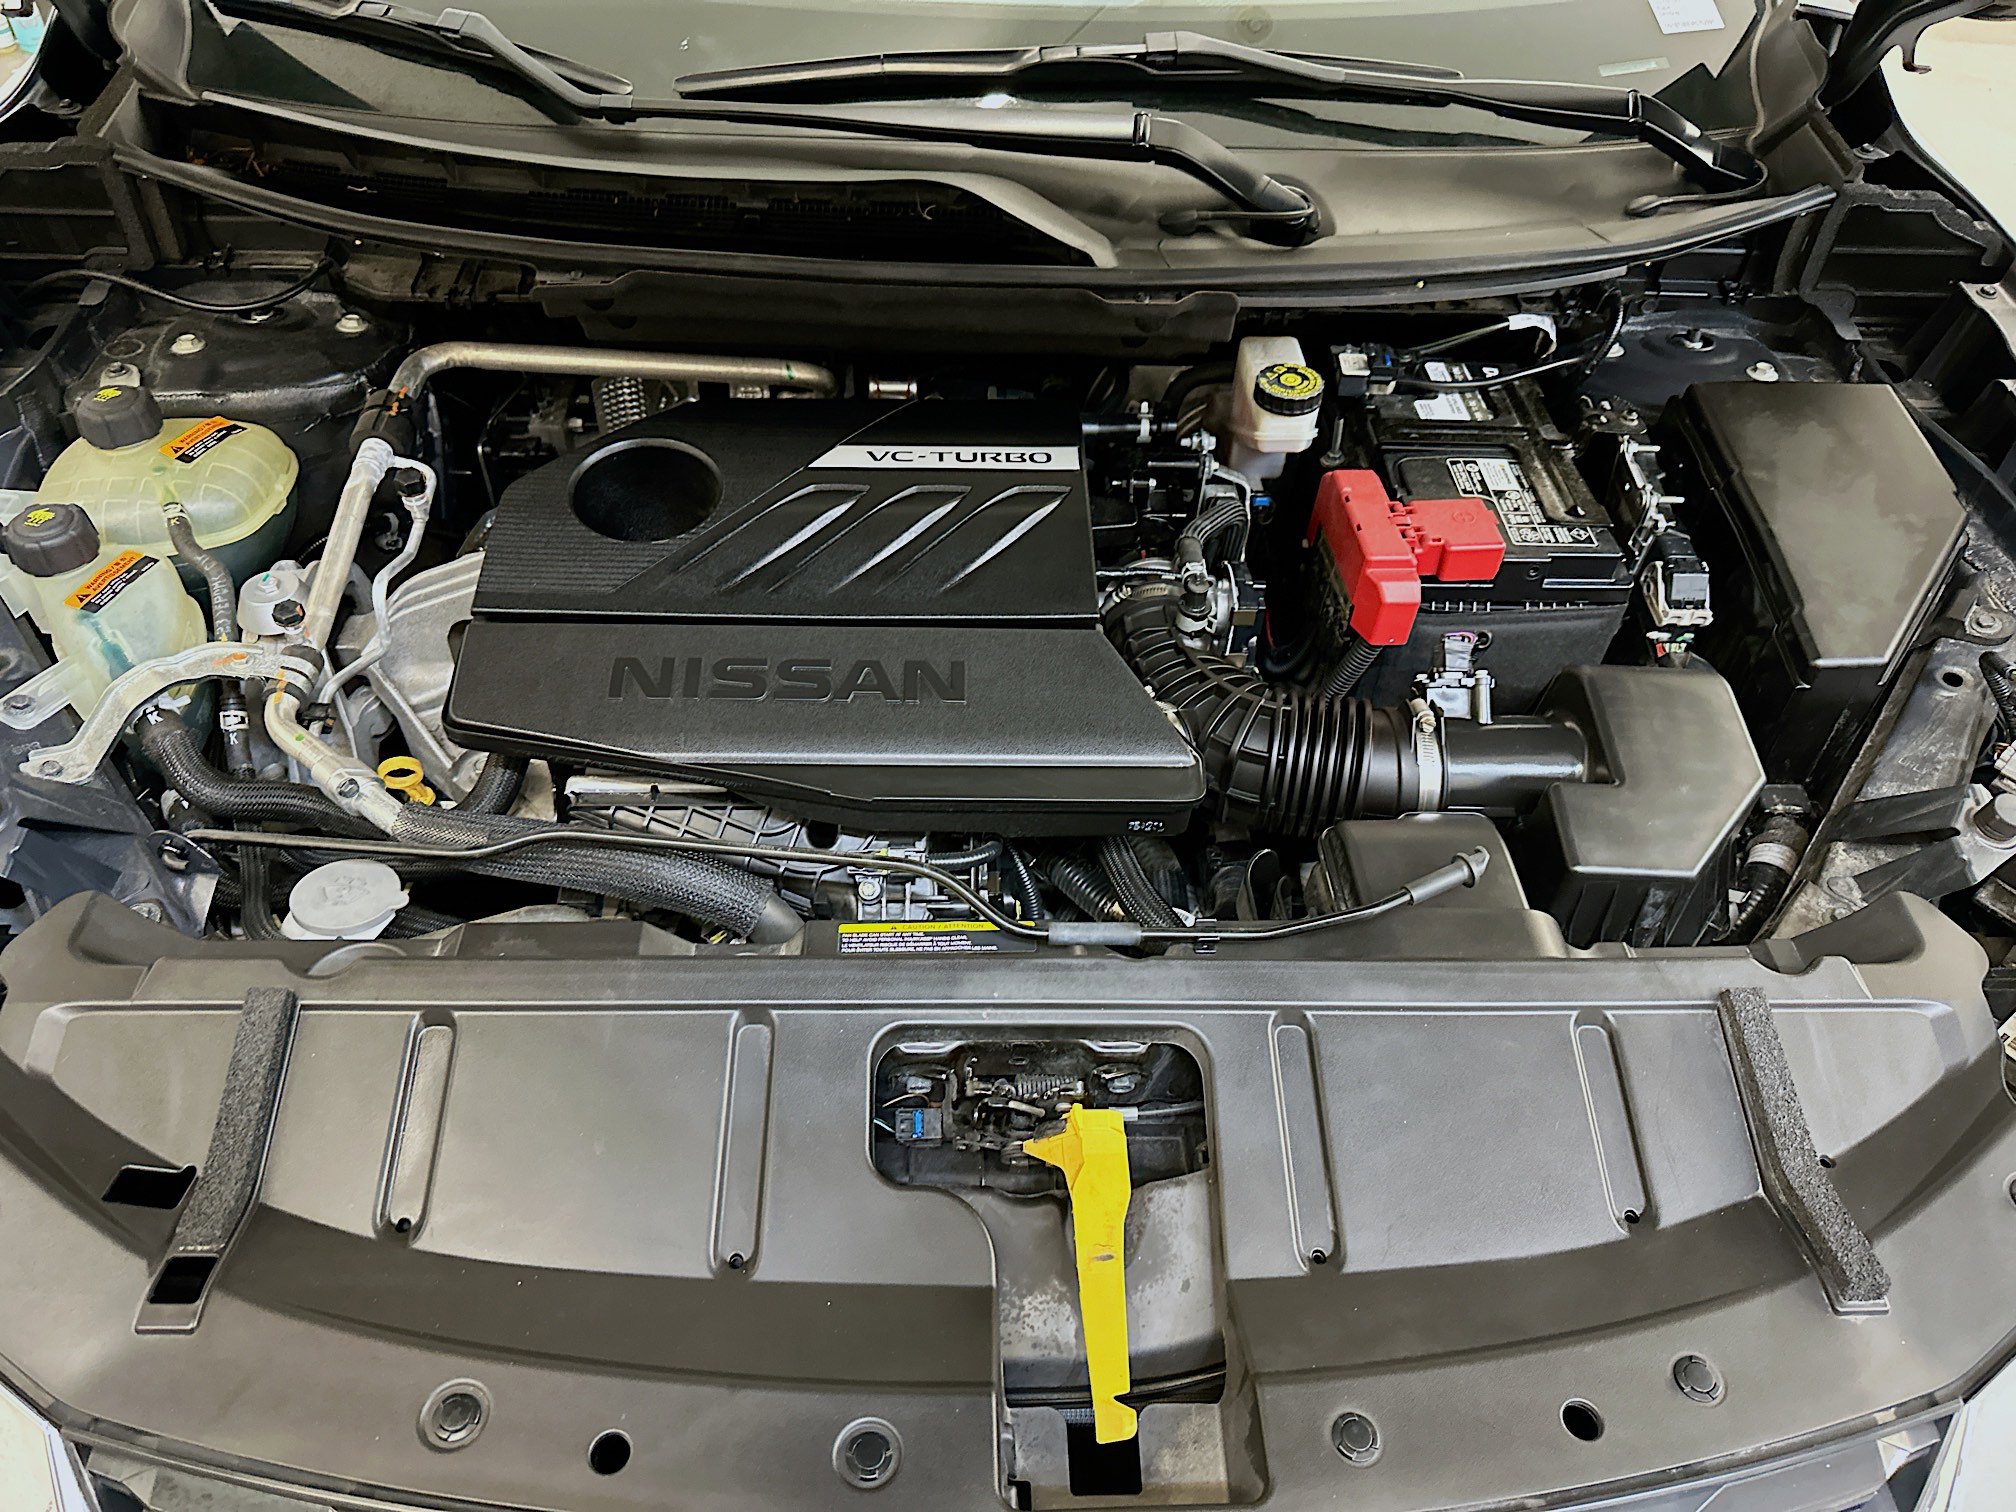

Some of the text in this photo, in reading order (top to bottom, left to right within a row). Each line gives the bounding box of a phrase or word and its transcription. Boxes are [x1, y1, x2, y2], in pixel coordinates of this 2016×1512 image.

[866, 450, 1053, 464] VC-TURBO
[607, 656, 968, 706] NISSAN
[228, 732, 239, 746] K
